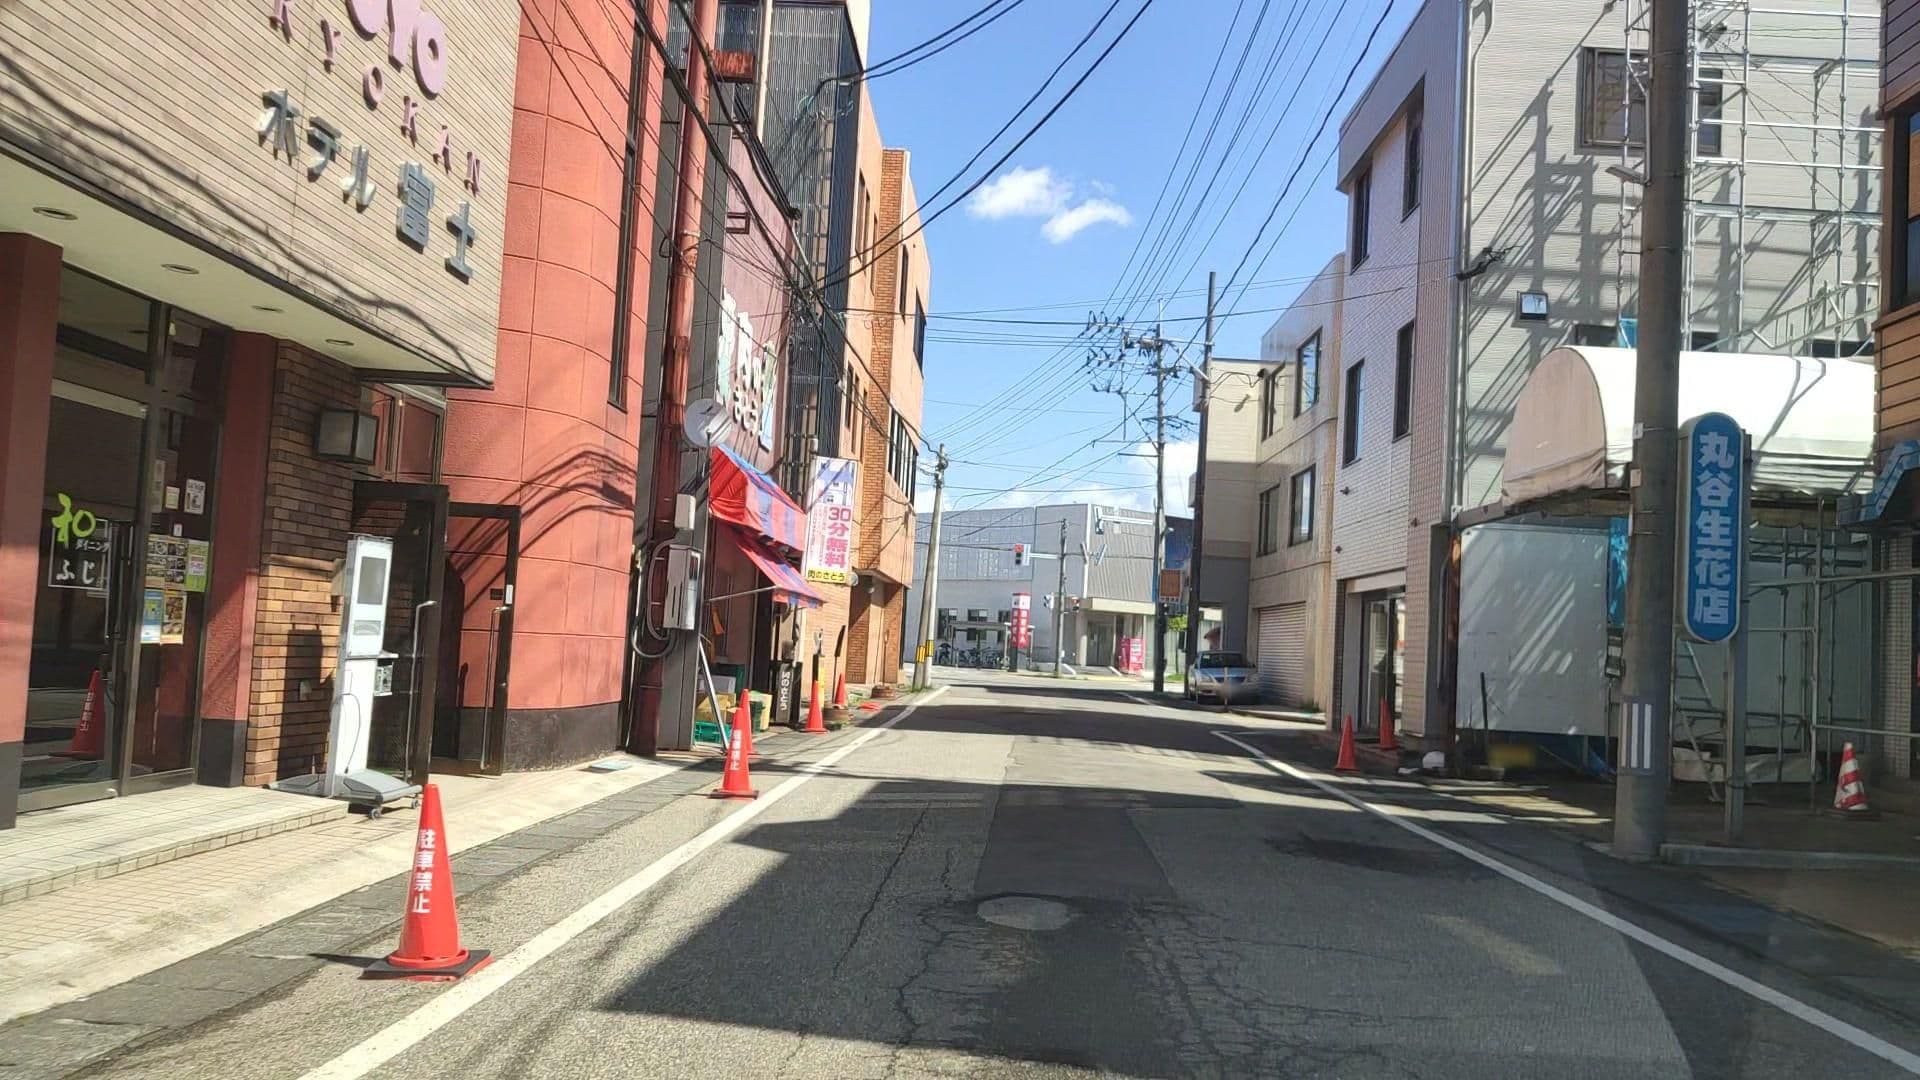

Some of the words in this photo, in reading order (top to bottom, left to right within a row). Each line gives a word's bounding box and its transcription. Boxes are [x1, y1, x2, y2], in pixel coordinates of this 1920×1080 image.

[256, 87, 476, 285] ホテル富士
[825, 507, 852, 568] 30分無料
[1695, 431, 1734, 624] 丸谷生花店
[55, 560, 95, 584] ふじ
[411, 829, 436, 914] 駐車禁止
